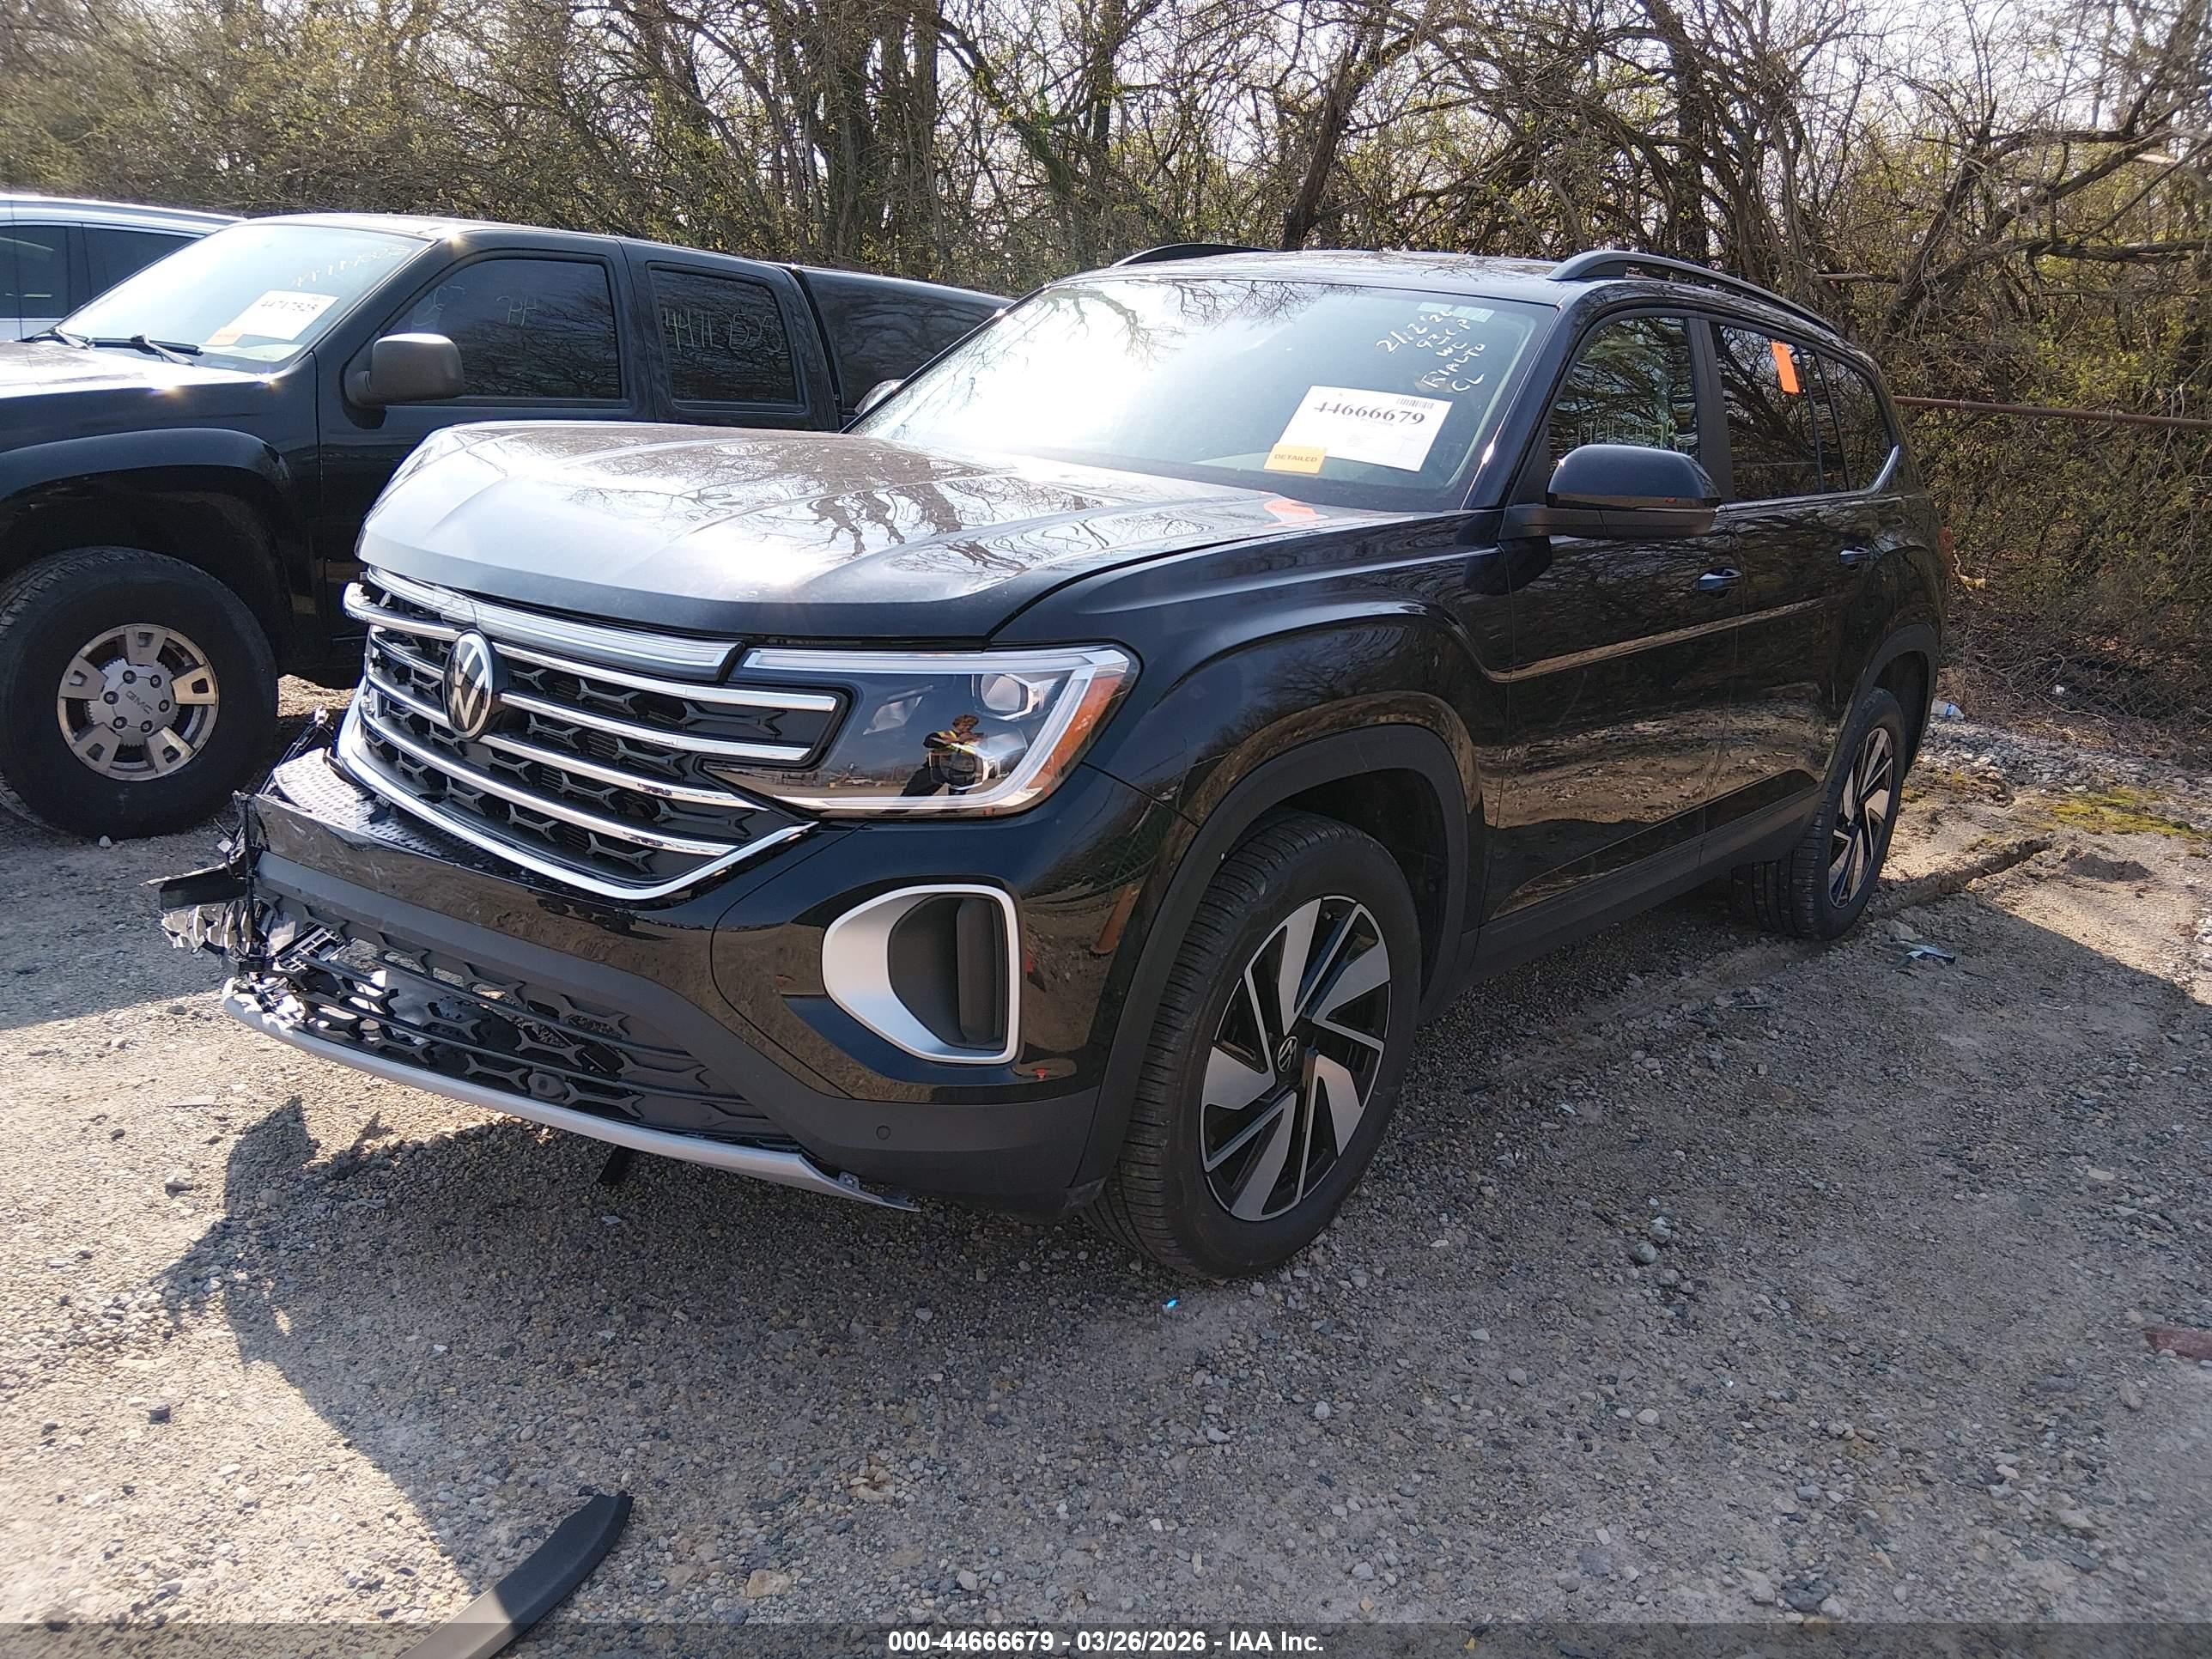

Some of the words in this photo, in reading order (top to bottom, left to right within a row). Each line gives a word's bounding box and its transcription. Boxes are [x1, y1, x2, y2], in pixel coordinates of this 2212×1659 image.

[1313, 401, 1426, 426] 44666679
[1274, 453, 1318, 463] DETAILED
[125, 690, 154, 714] GMC
